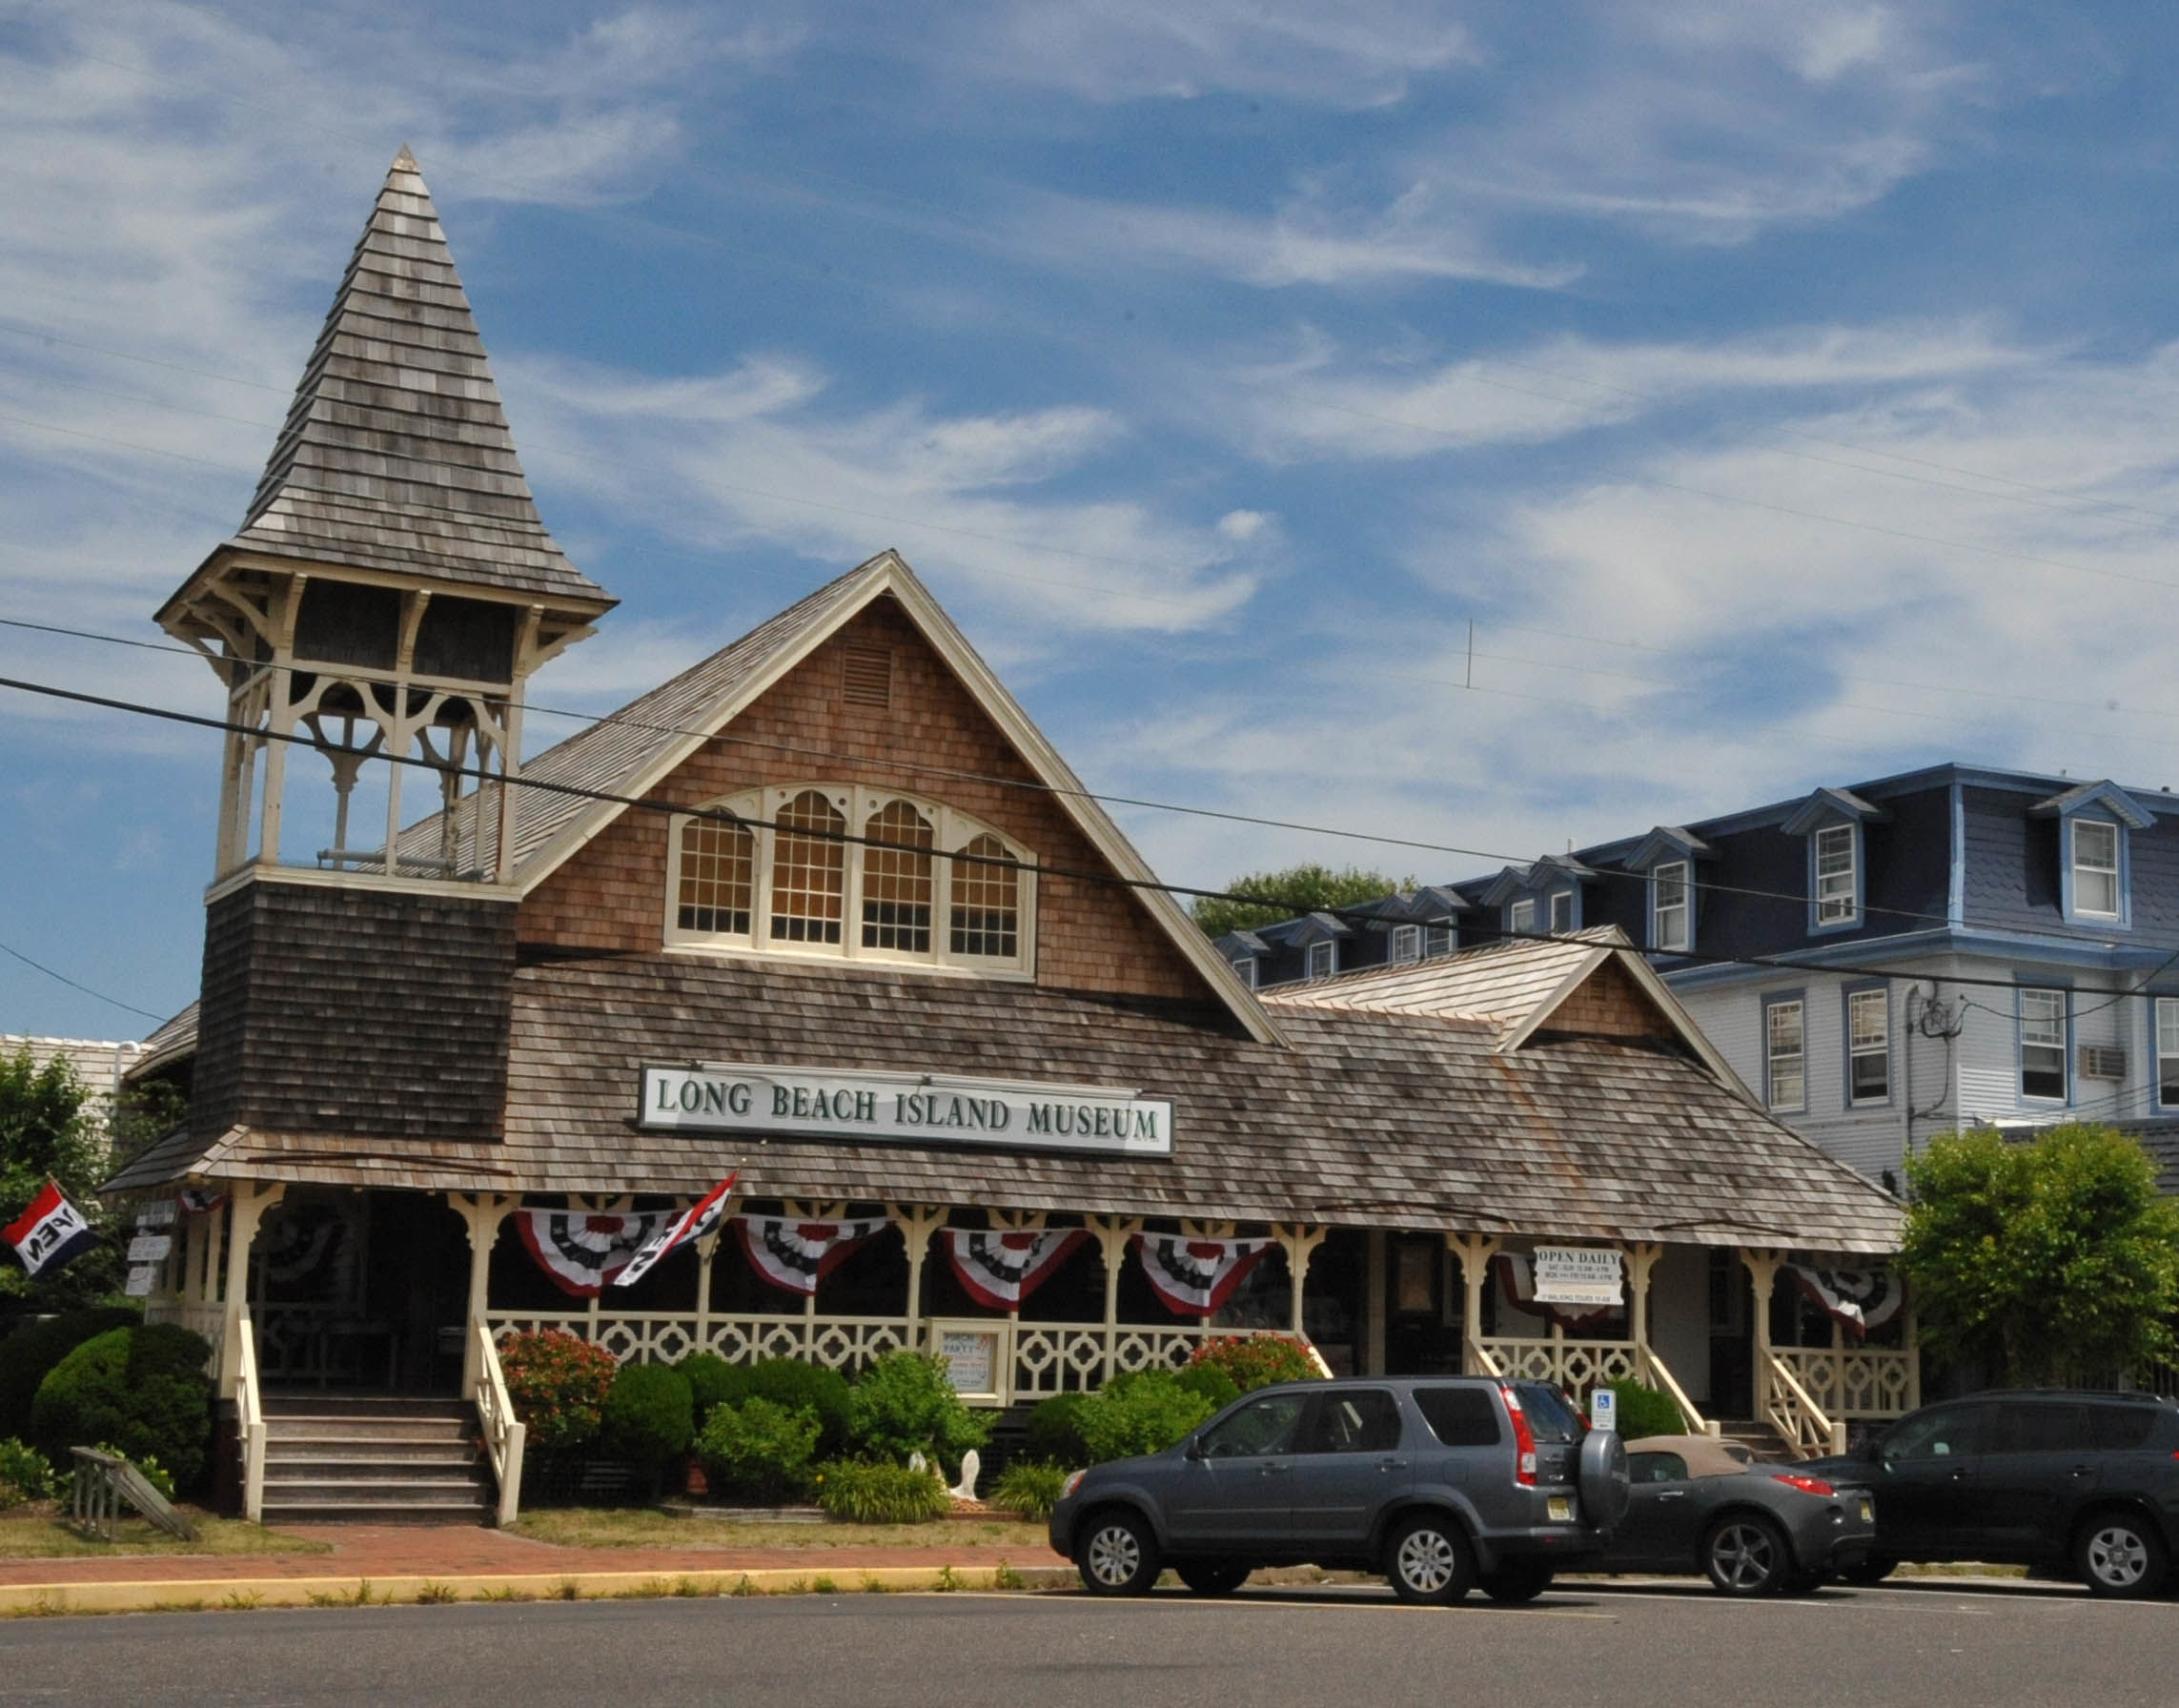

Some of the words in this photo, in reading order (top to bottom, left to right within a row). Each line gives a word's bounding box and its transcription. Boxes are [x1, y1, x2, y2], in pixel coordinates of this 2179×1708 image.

[657, 1078, 753, 1115] LONG
[771, 1085, 877, 1124] BEACH
[894, 1092, 1010, 1131] ISLAND
[1026, 1102, 1160, 1141] MUSEUM
[1539, 1251, 1574, 1263] OPEN
[1578, 1252, 1618, 1265] DAILY
